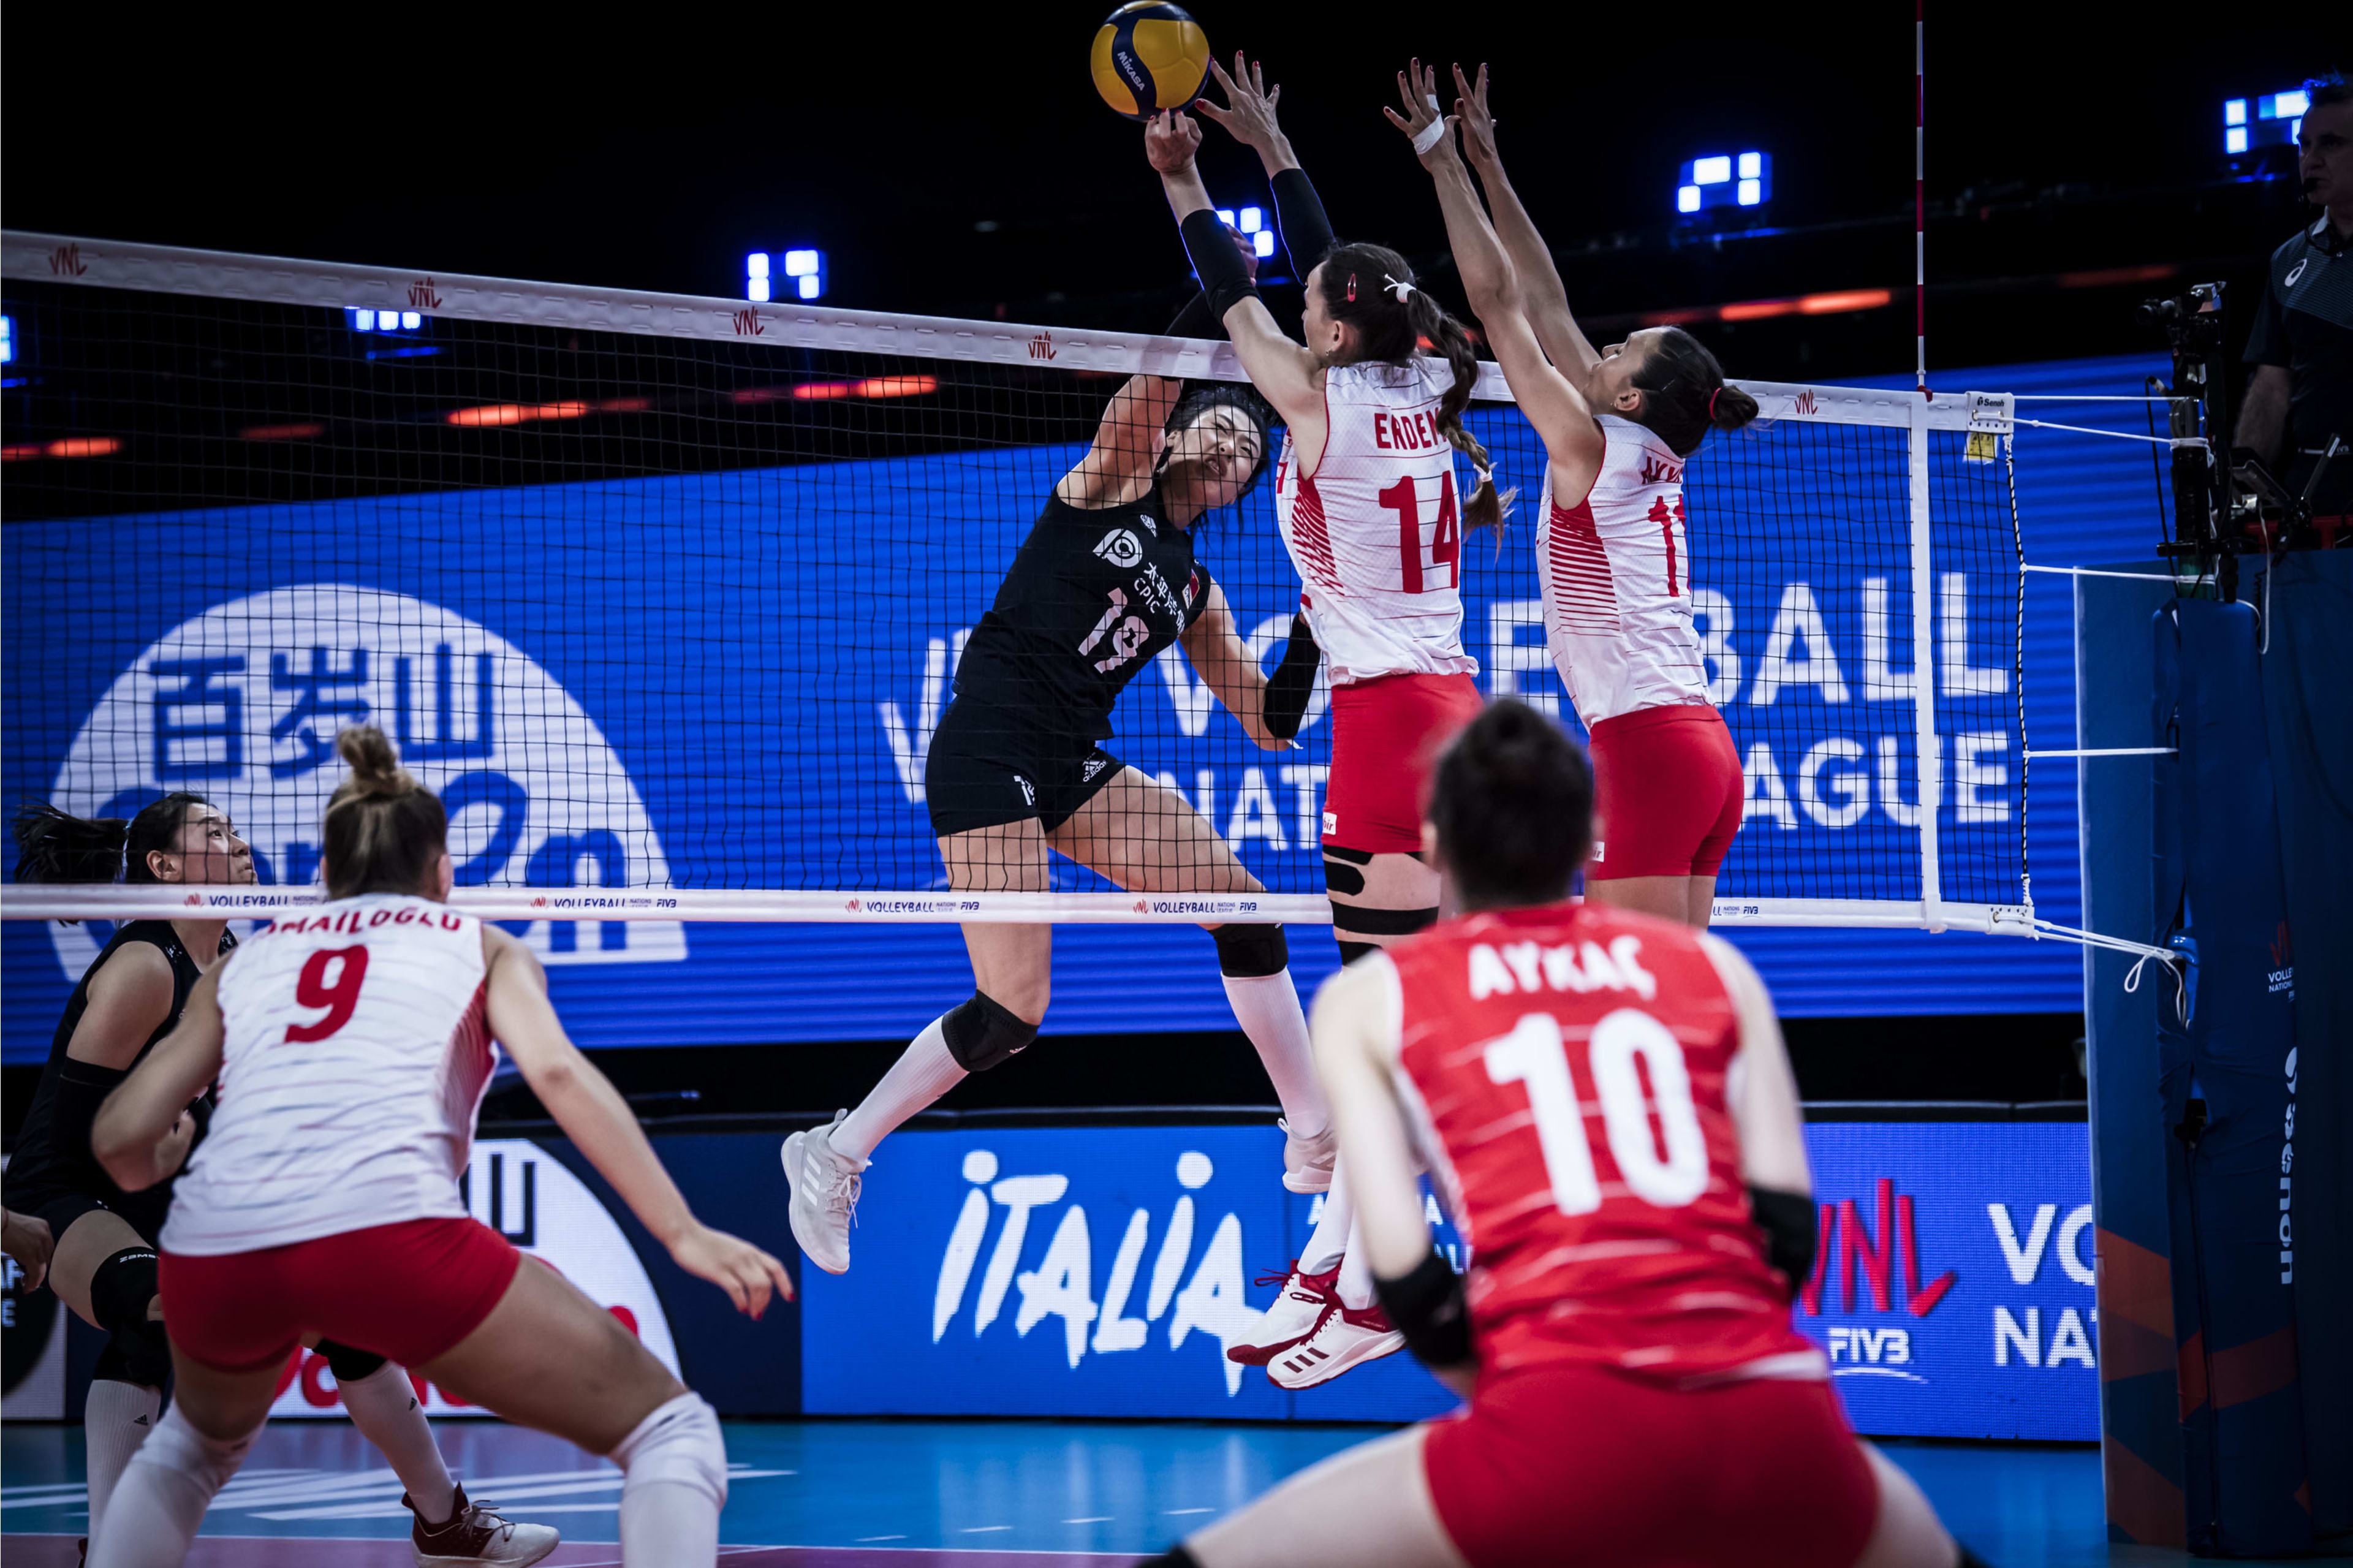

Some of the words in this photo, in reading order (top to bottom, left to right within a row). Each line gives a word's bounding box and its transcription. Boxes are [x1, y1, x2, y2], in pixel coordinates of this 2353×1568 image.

[48, 243, 88, 278] VNL
[408, 277, 442, 309] VNL
[733, 306, 765, 336] VNL
[1028, 330, 1057, 361] VNL
[1794, 388, 1819, 415] VNL
[1379, 470, 1460, 594] 14
[1134, 577, 1161, 614] CPIC
[150, 642, 494, 781] 百岁山
[1737, 731, 2011, 832] AGUE
[656, 898, 677, 908] FIVB
[866, 901, 934, 913] VOLLEYBALL
[960, 901, 980, 911] FIVB
[1132, 898, 1149, 914] VNL
[1153, 902, 1215, 914] VOLLEYBALL
[1240, 902, 1257, 911] FIVB
[283, 944, 369, 1044] 9
[1483, 1008, 1710, 1217] 10
[119, 1253, 160, 1263] ZAMS
[1800, 1178, 1957, 1317] VNL
[1828, 1327, 1911, 1364] FIVB
